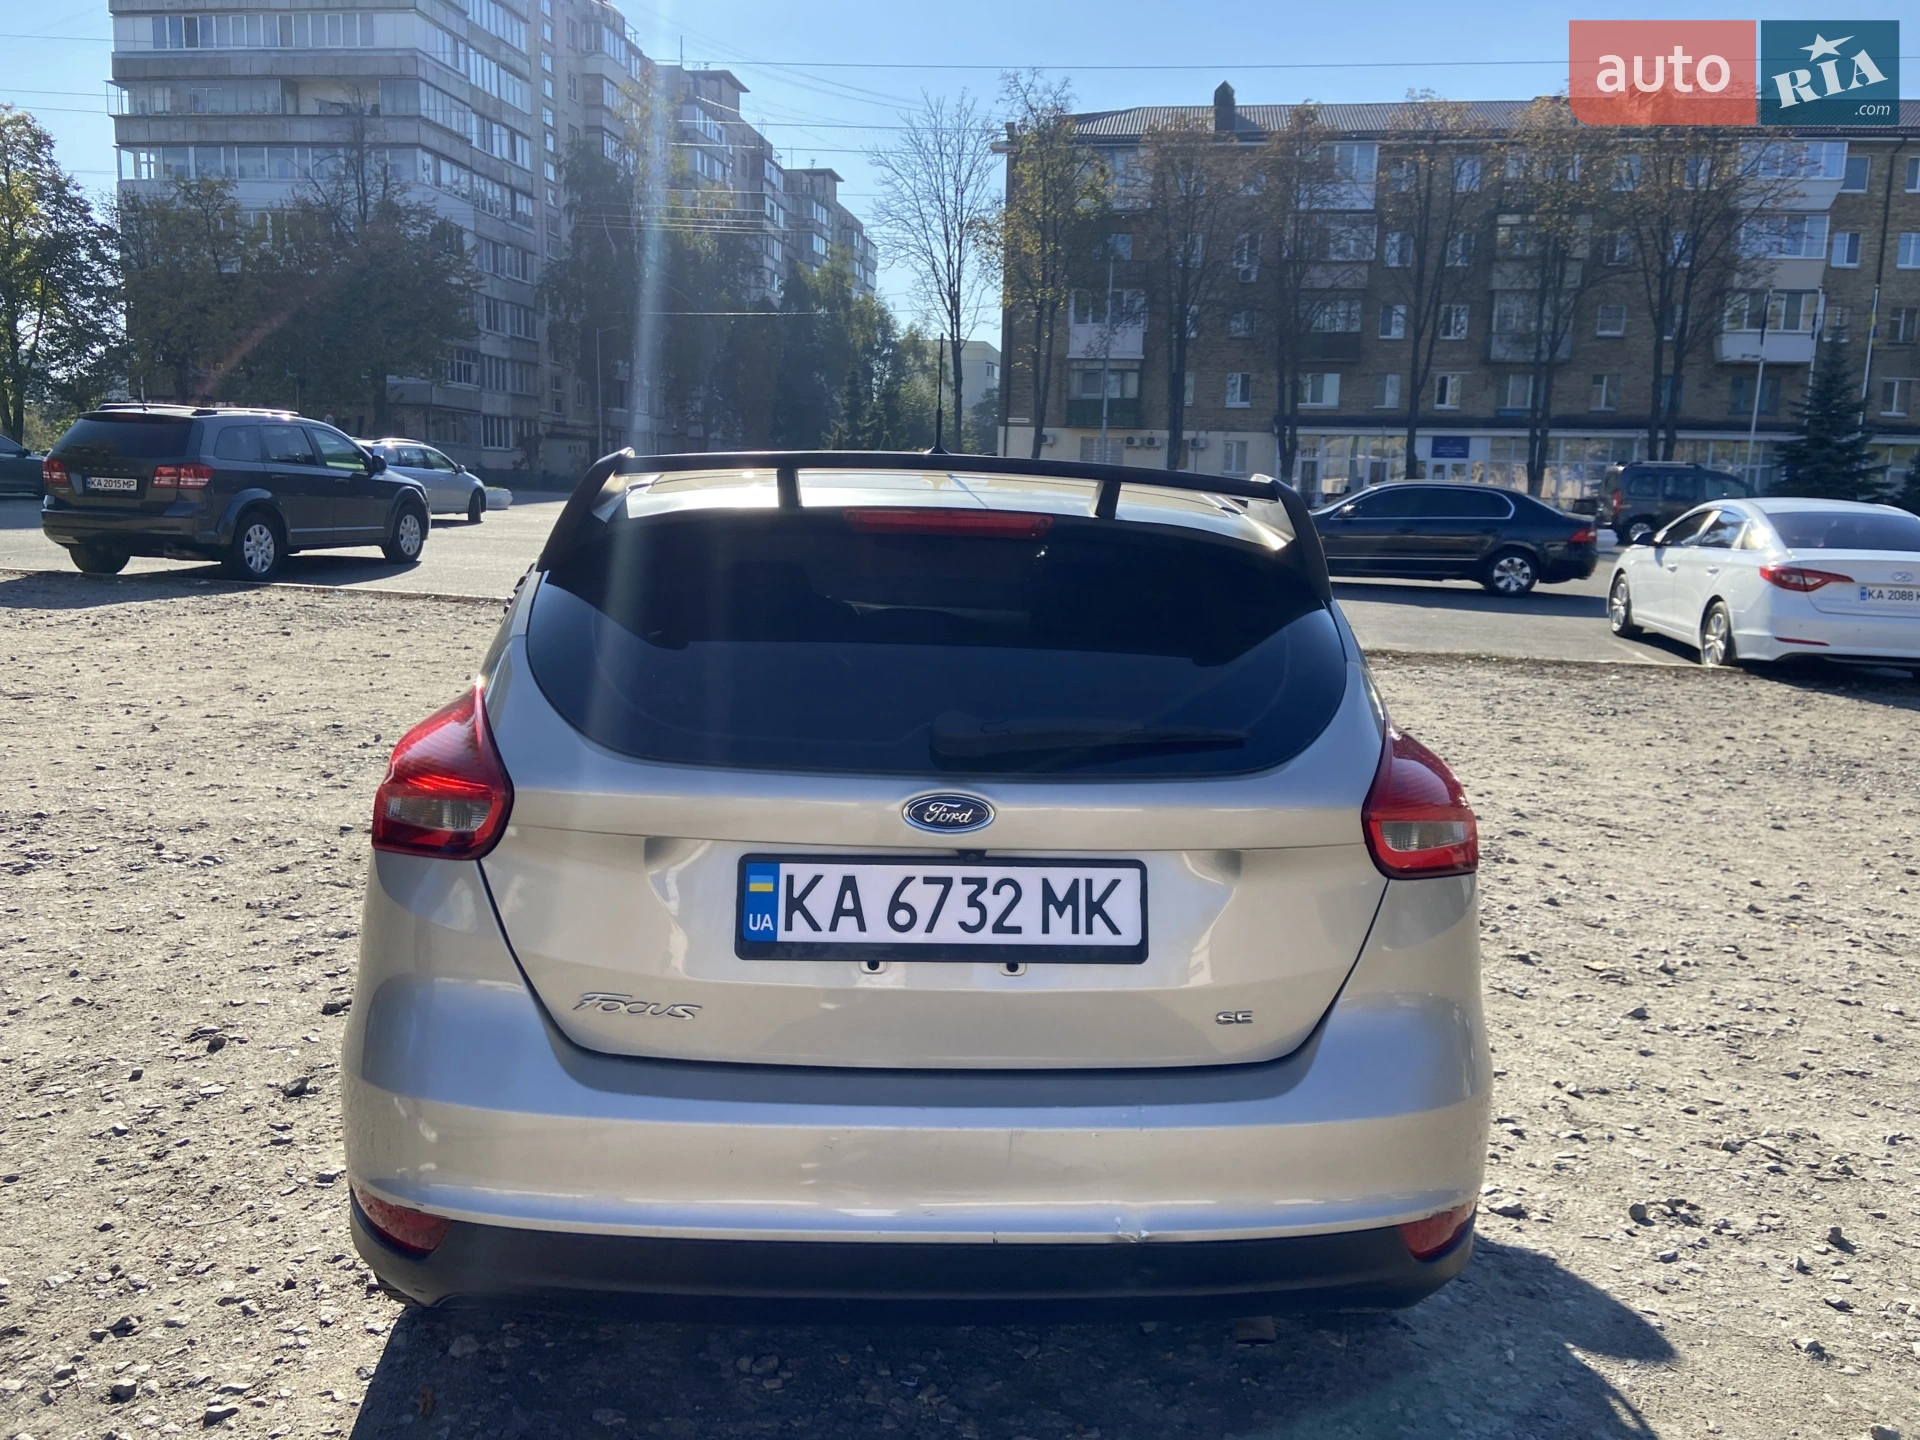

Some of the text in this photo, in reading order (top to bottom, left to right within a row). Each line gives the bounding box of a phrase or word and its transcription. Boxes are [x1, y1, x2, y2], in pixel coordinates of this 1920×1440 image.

[91, 479, 135, 489] KA 2015 MP
[1868, 589, 1885, 600] KA
[1888, 590, 1914, 601] 2088
[923, 801, 973, 824] Ford
[784, 874, 1122, 936] KA 6732 MK
[749, 913, 774, 931] UA
[1215, 1010, 1253, 1025] SE
